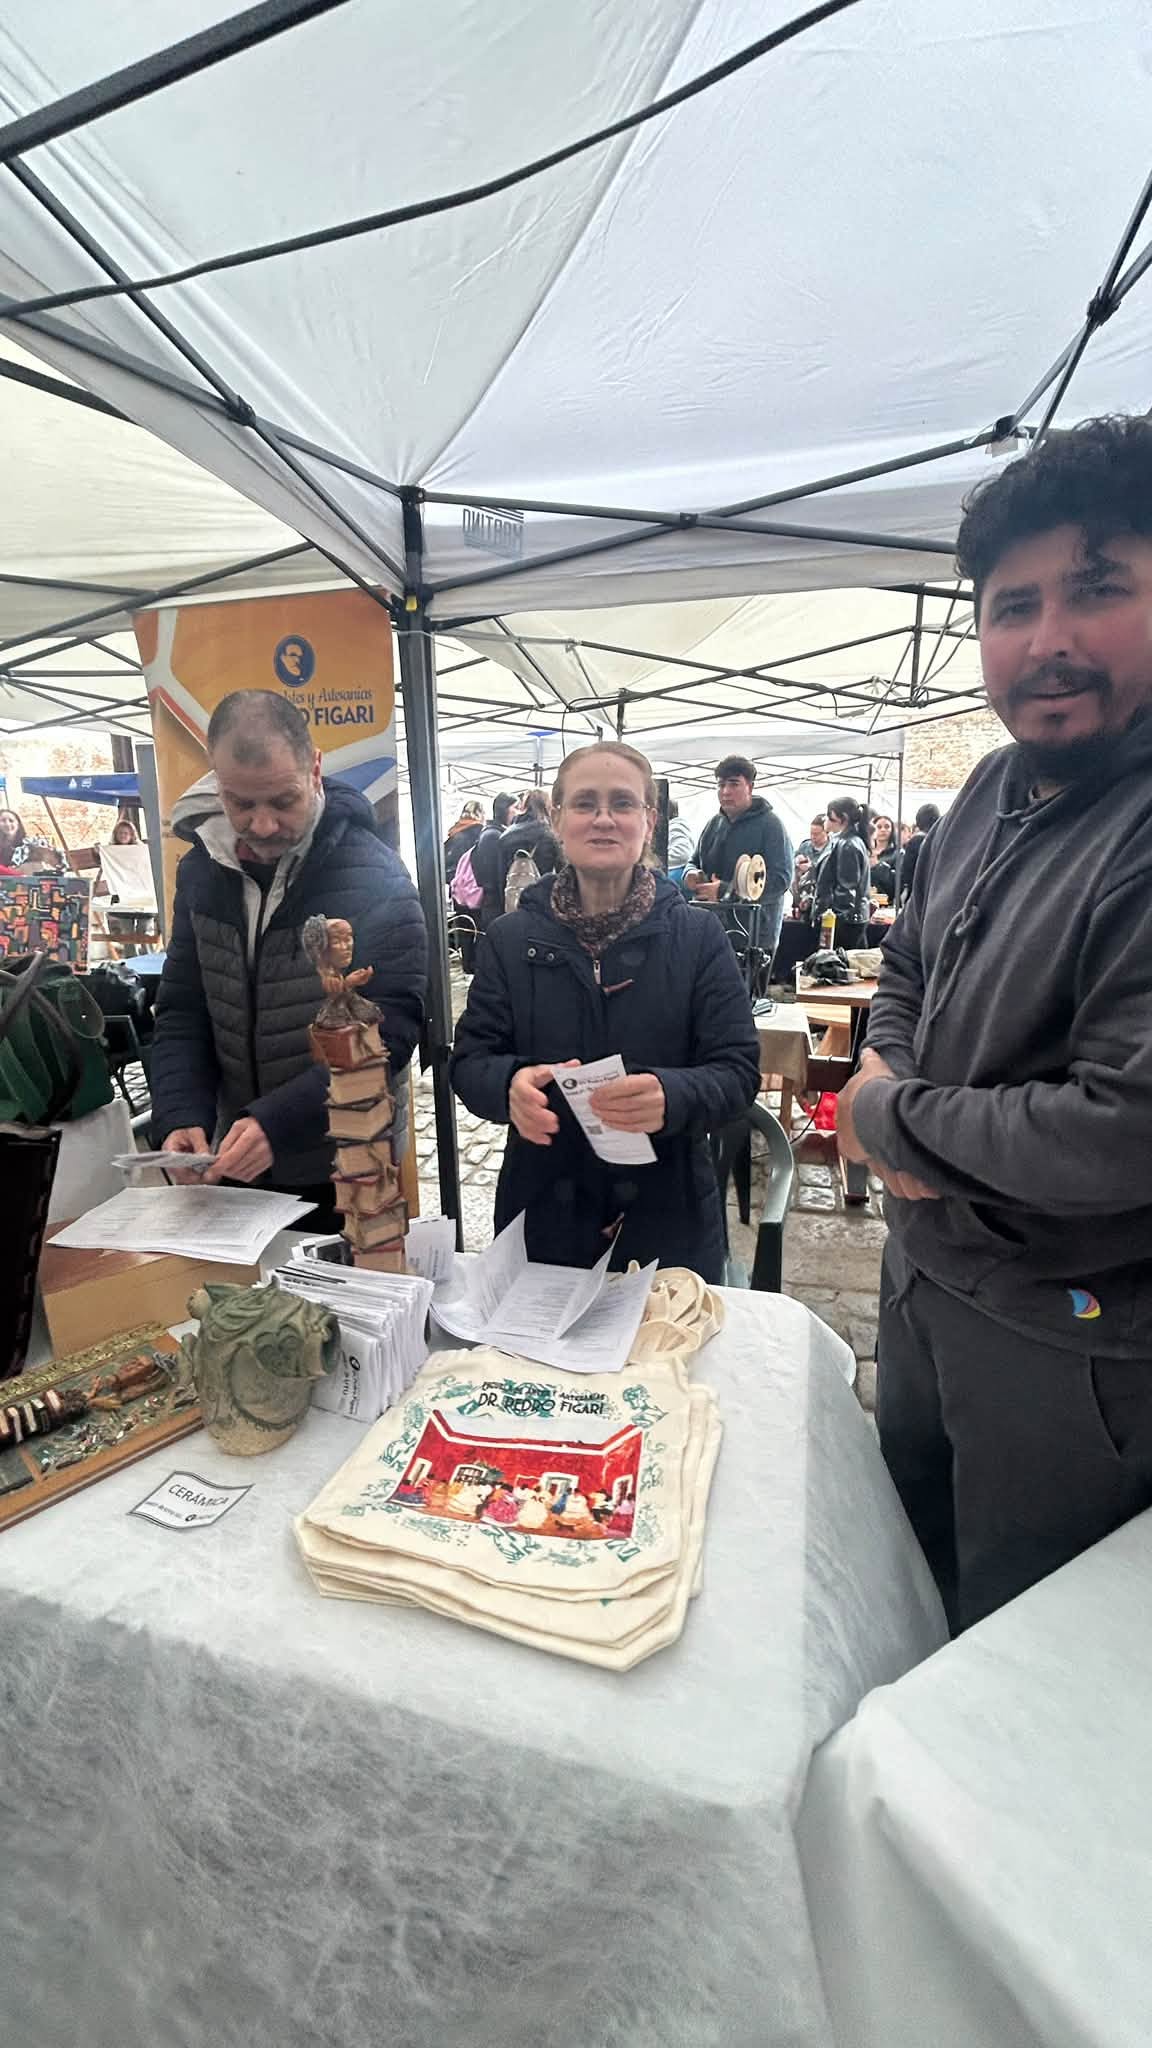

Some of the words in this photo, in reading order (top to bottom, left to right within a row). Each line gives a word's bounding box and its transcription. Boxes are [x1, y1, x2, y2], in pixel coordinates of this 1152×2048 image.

[314, 704, 374, 726] FIGARI
[479, 1392, 500, 1407] DR.
[560, 1400, 604, 1415] FIGARI
[168, 1484, 230, 1507] CERÁMICA
